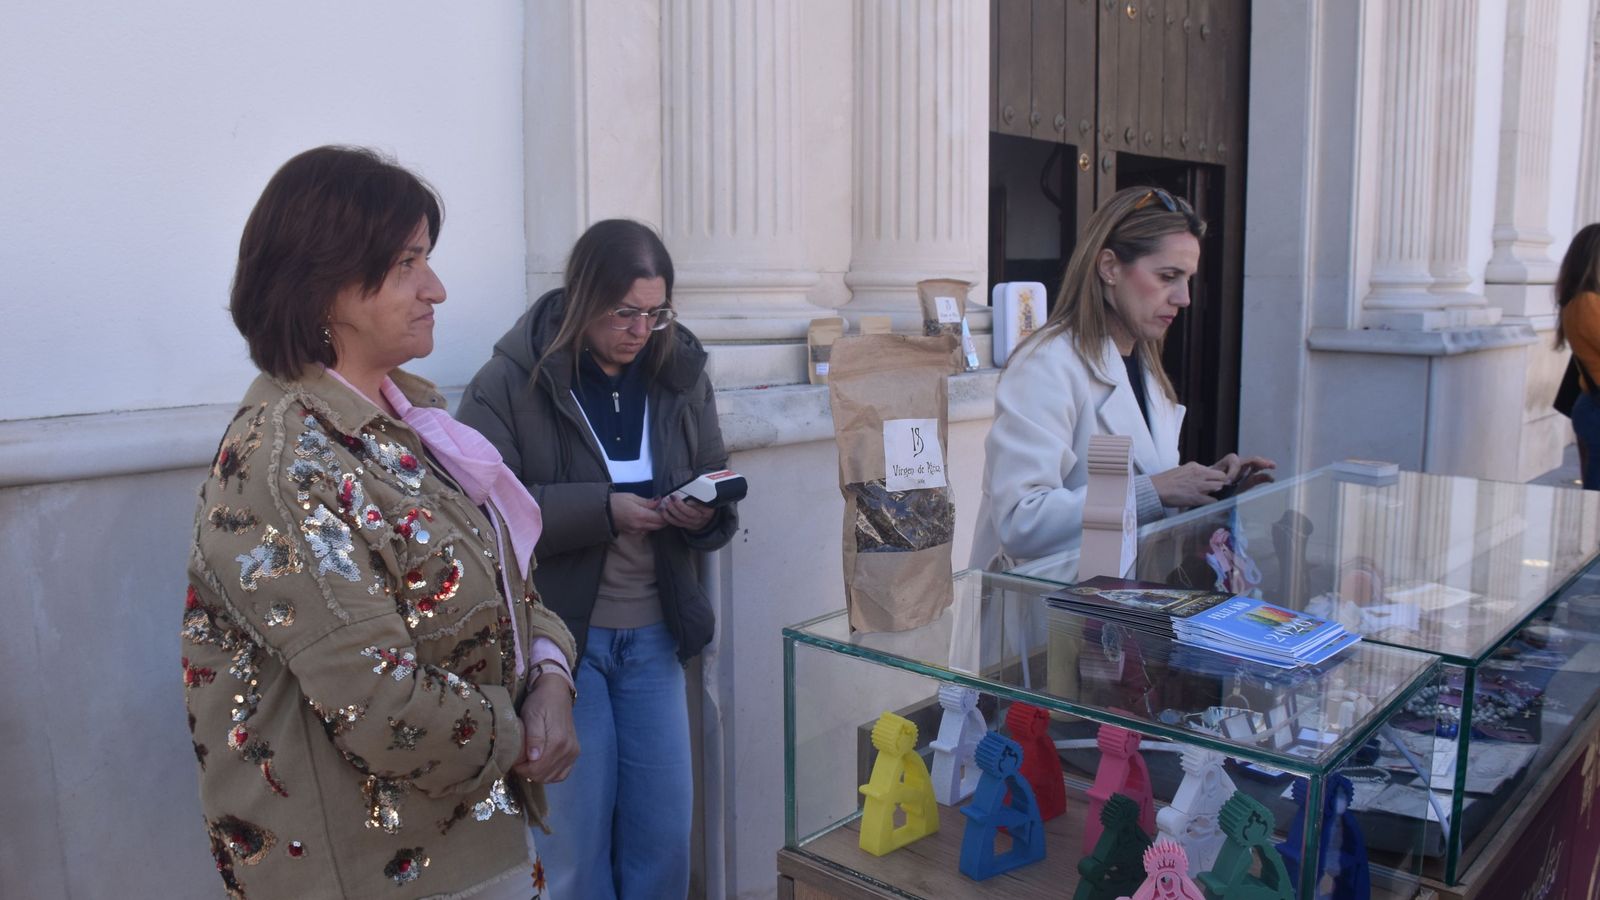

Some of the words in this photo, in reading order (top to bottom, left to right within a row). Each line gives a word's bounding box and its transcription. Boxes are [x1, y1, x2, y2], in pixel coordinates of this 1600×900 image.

[893, 465, 915, 478] Virgen
[917, 465, 925, 474] de
[1208, 607, 1236, 621] FELIZ
